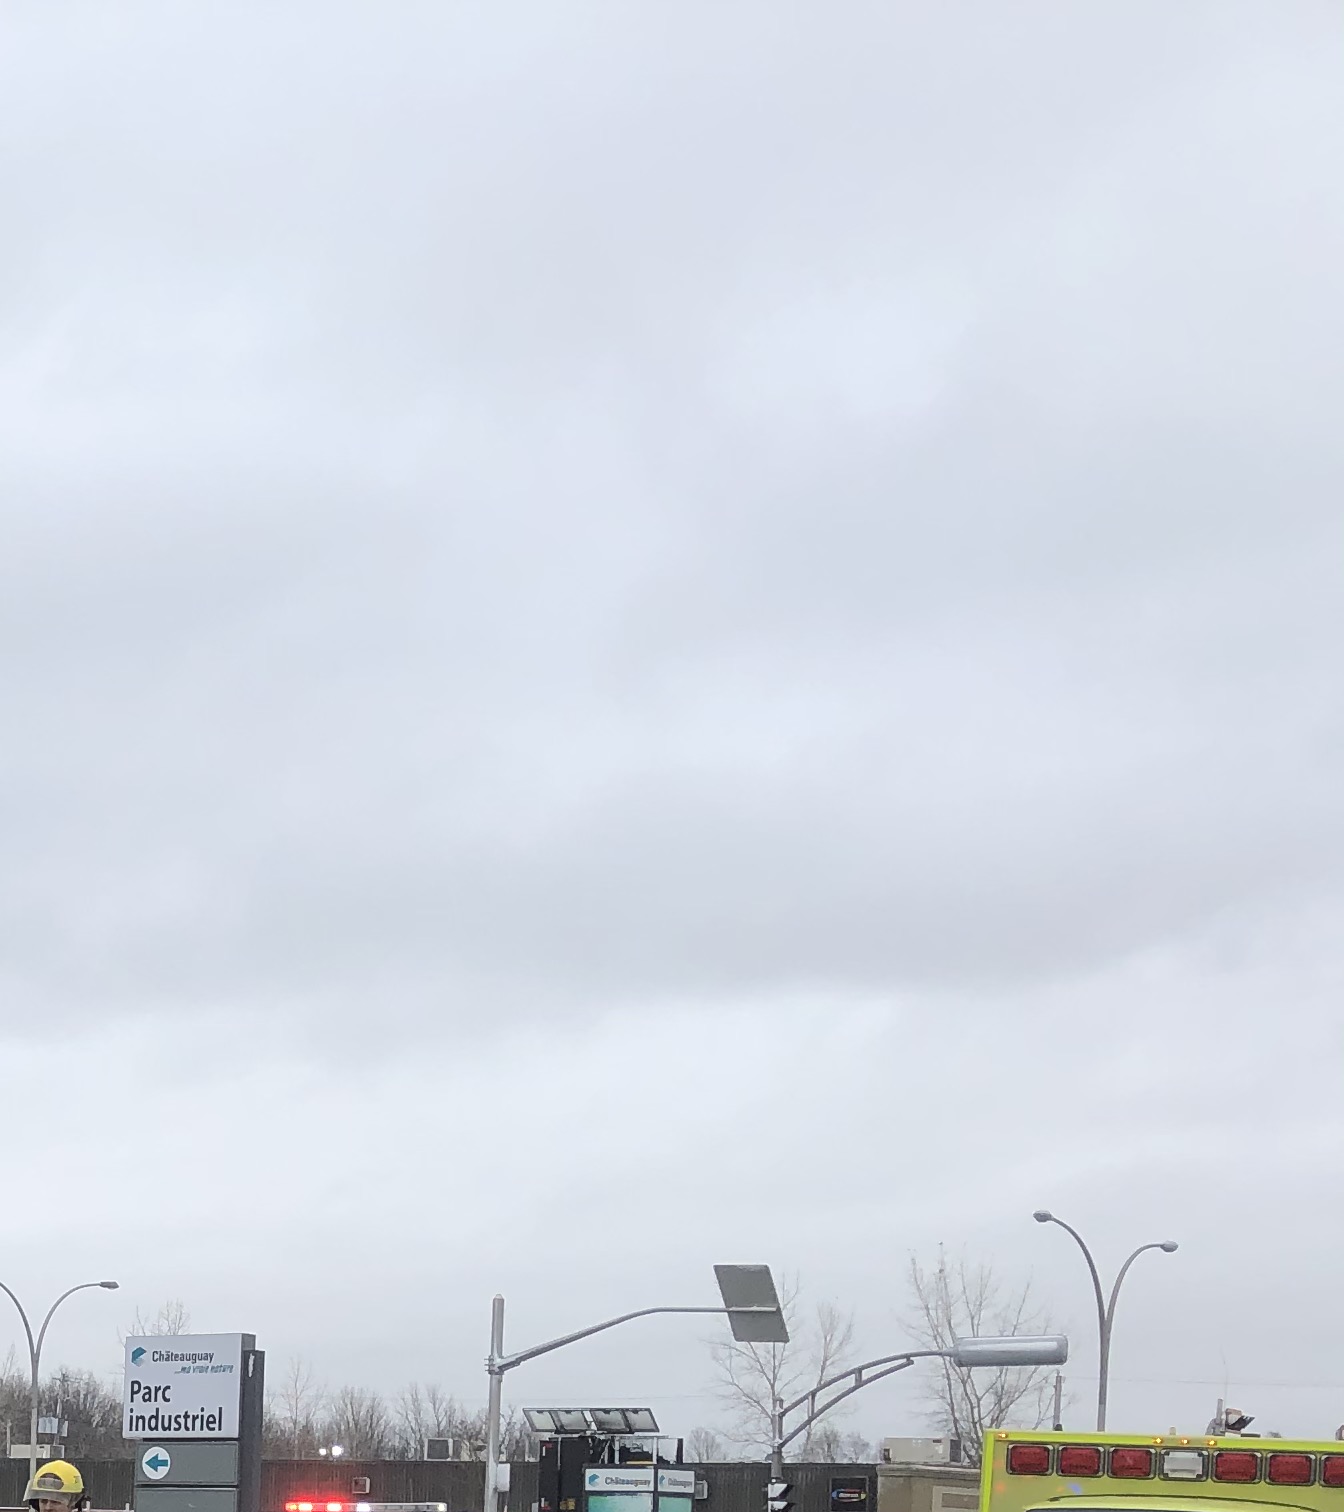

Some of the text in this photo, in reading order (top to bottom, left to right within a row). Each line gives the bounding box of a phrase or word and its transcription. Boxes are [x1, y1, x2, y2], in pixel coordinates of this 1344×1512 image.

[152, 1350, 214, 1364] Châteauguay
[130, 1380, 171, 1403] Parc
[129, 1407, 223, 1432] industriel
